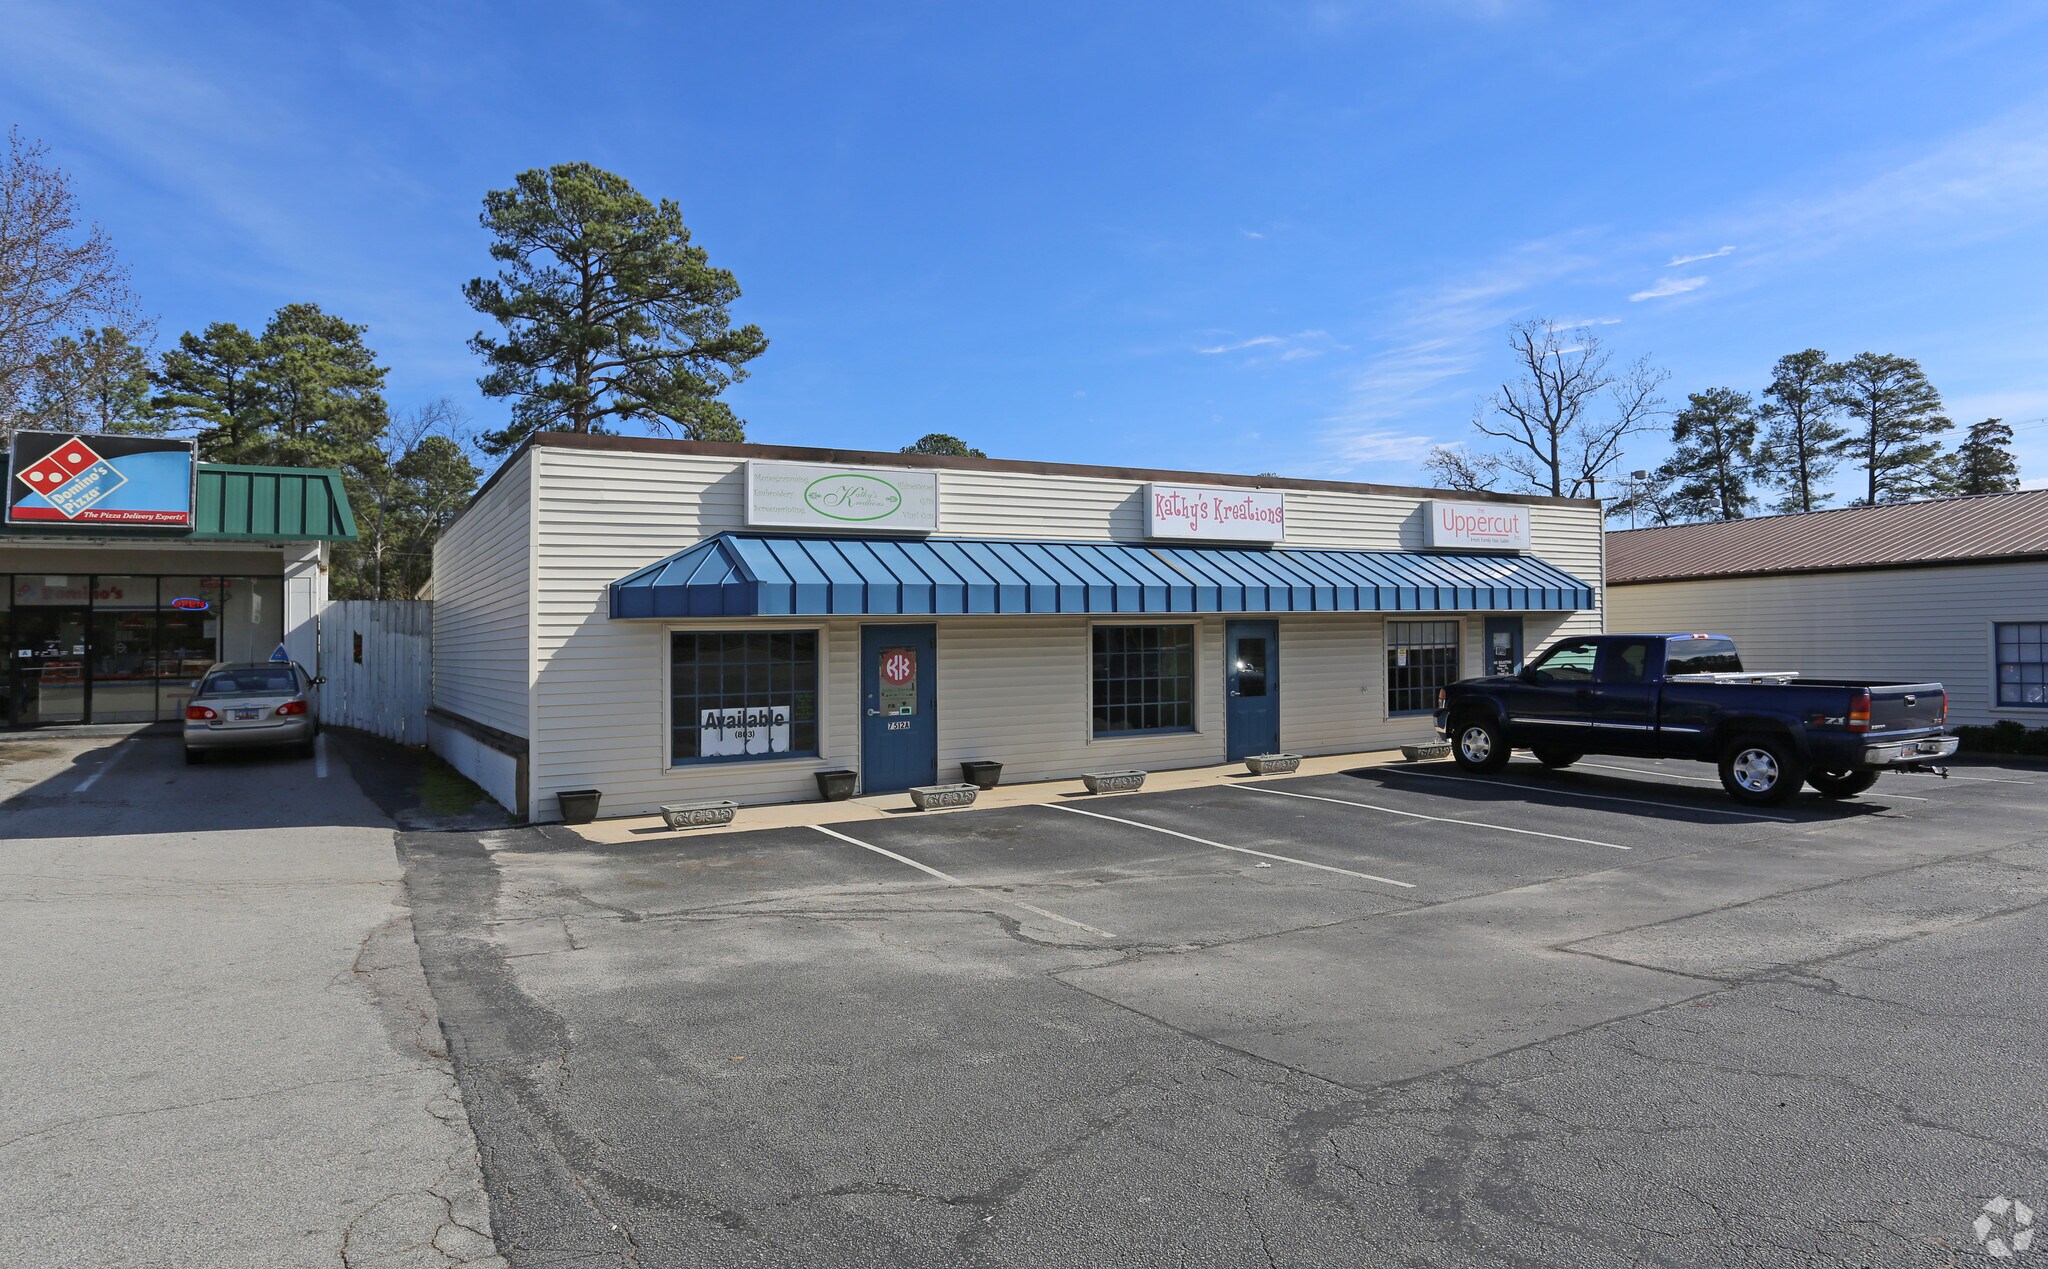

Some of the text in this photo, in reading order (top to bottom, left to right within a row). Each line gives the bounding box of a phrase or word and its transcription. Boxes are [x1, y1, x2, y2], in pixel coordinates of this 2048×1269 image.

[51, 466, 108, 505] Domino's
[62, 490, 101, 514] Pizza
[1155, 491, 1283, 532] Kathy's Kreations
[84, 511, 98, 519] The
[123, 513, 153, 521] Delivery
[155, 513, 183, 521] Experts
[1443, 508, 1520, 538] Uppercut
[173, 600, 205, 608] OPEN
[705, 708, 785, 730] Available
